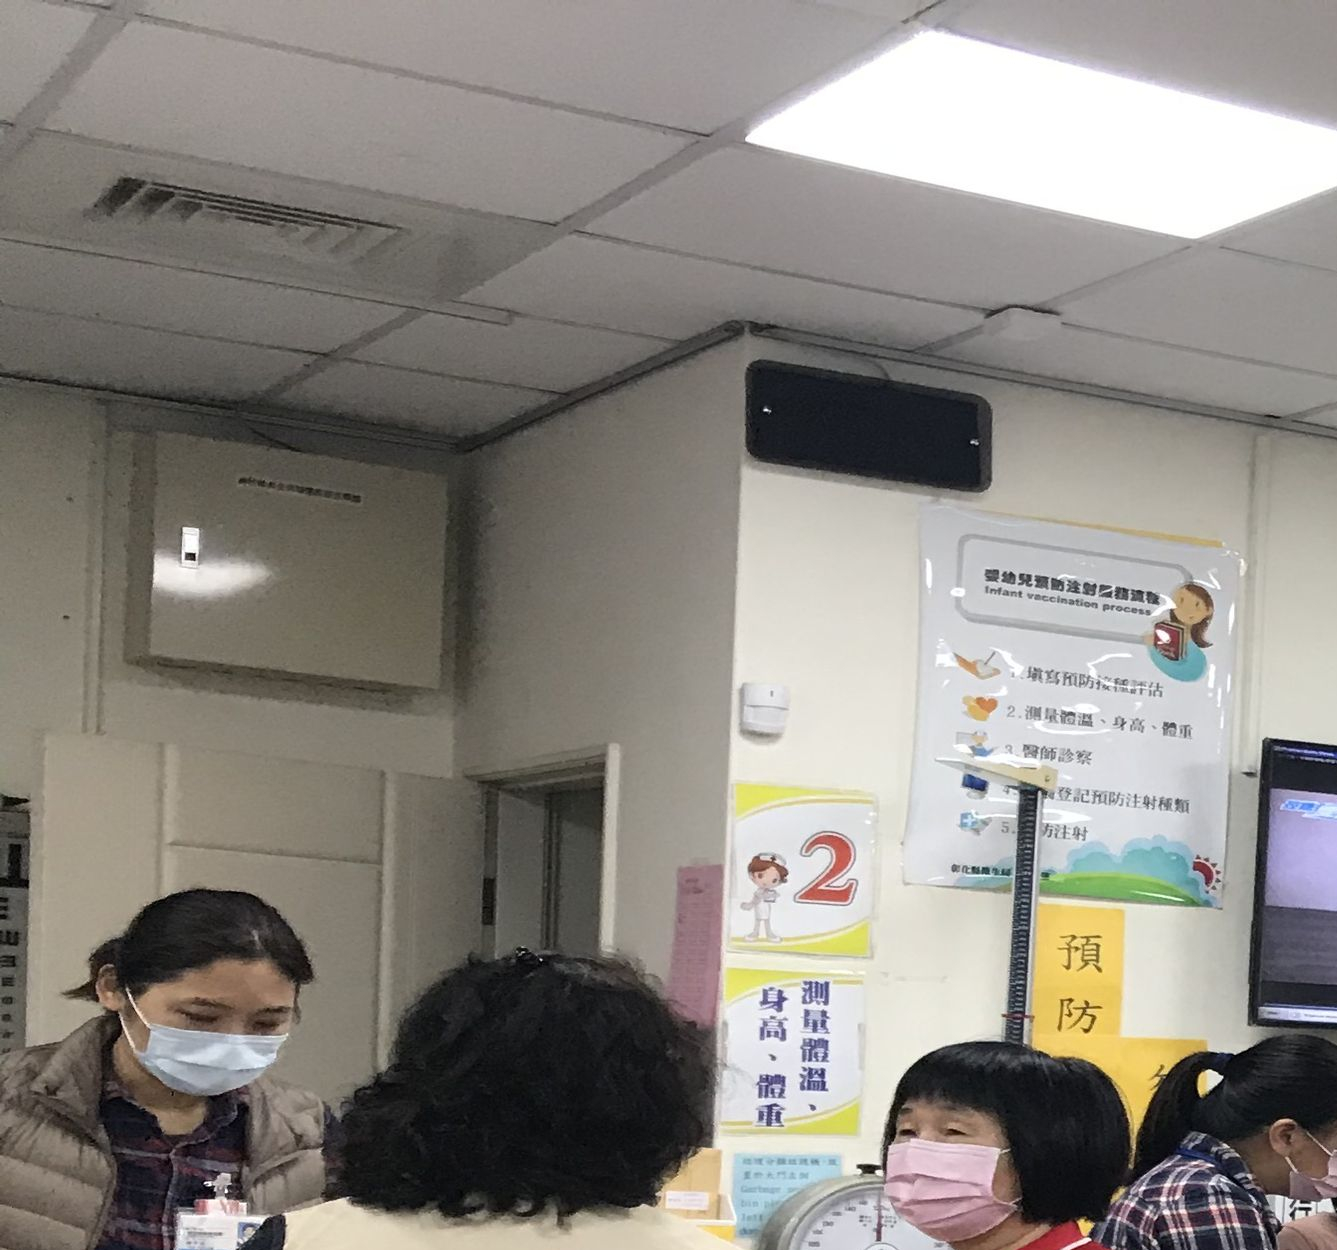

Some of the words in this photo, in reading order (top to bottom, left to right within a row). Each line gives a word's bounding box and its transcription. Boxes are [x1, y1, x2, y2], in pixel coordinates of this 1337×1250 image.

[984, 586, 1022, 598] Infant
[1027, 592, 1098, 609] vaccination
[1103, 604, 1151, 616] process
[794, 831, 859, 906] 2
[1056, 934, 1103, 1033] 預防
[753, 987, 789, 1128] 身高、體重
